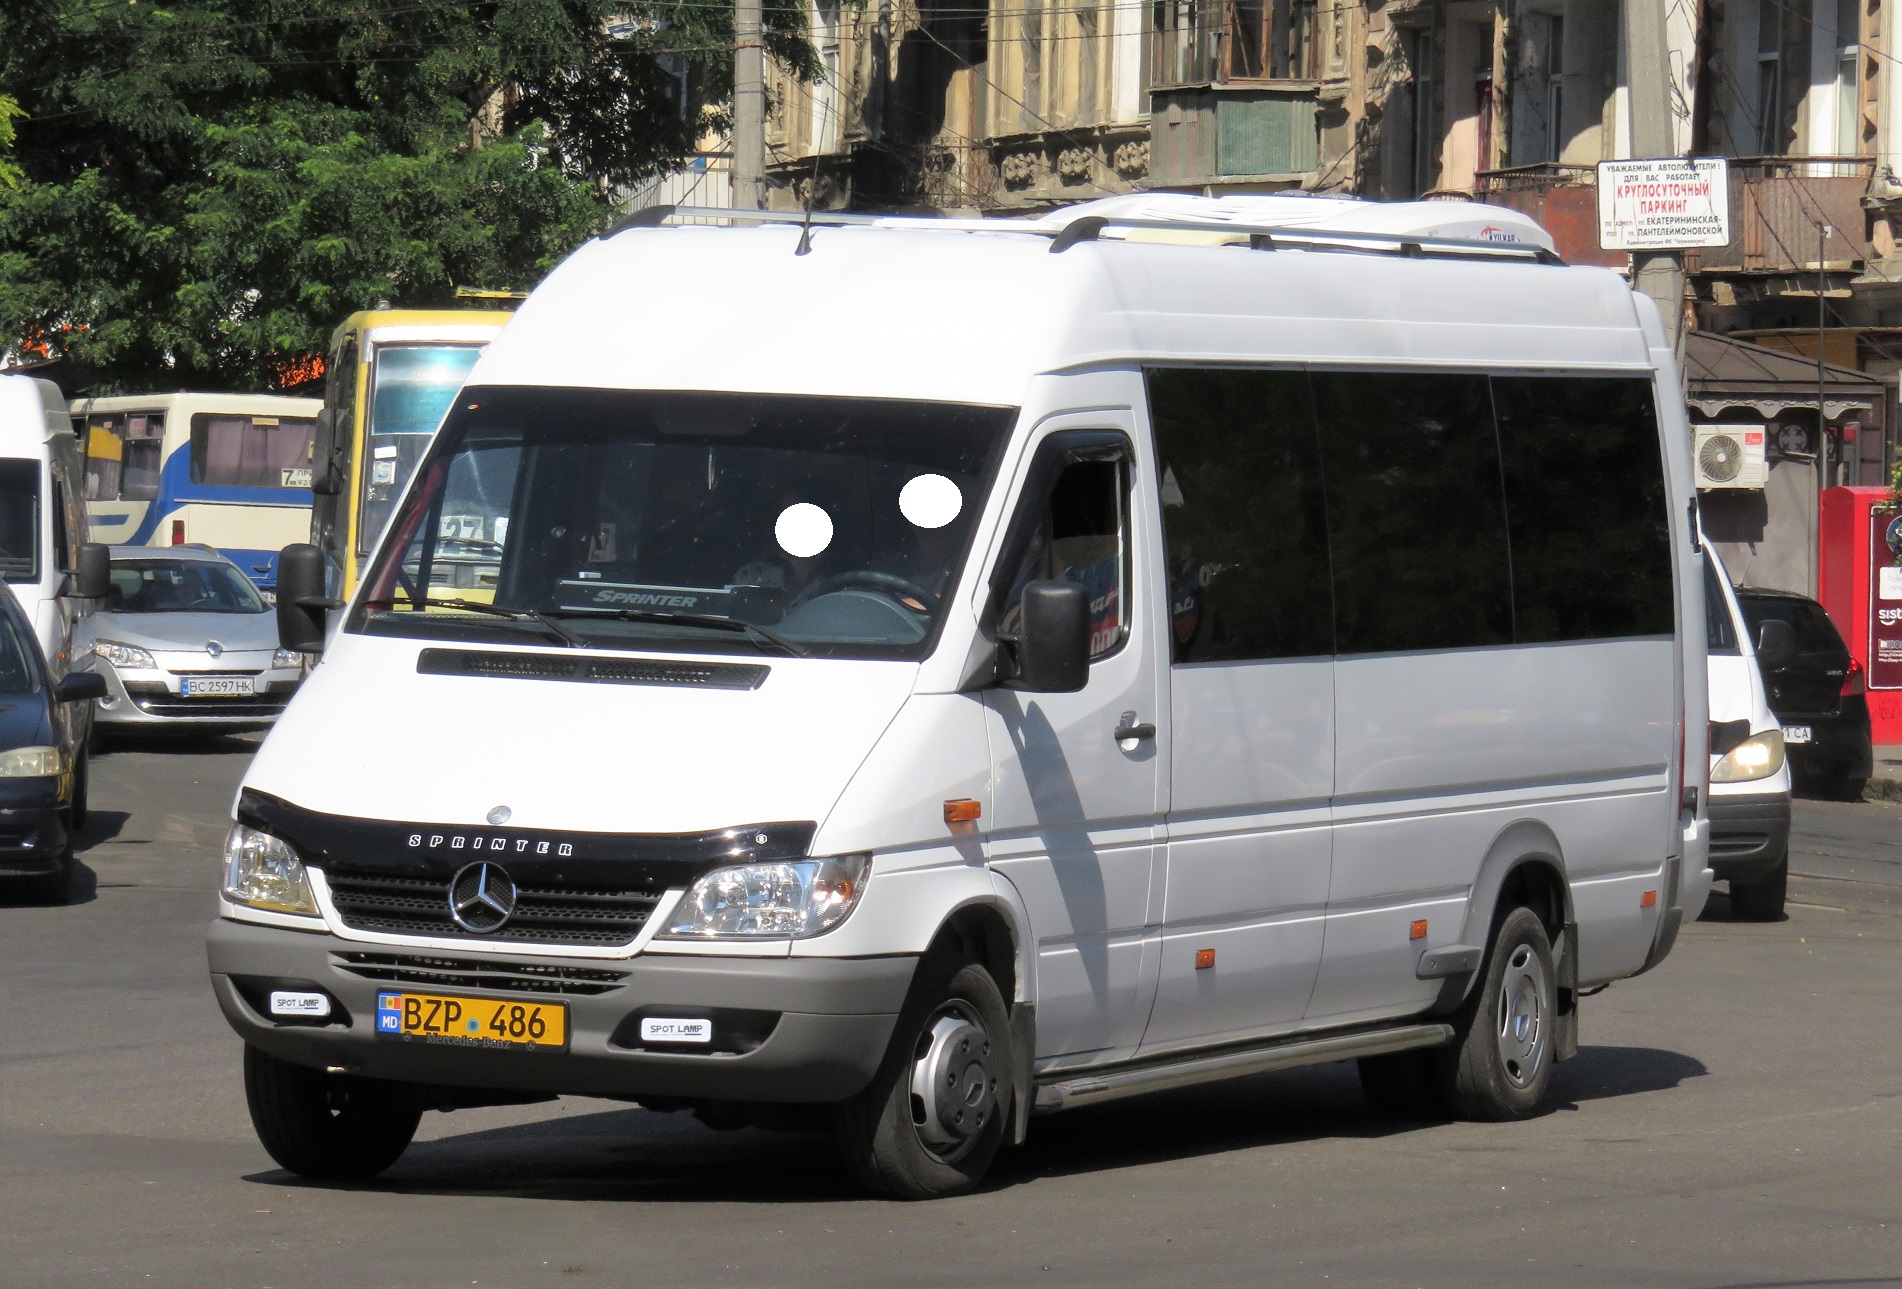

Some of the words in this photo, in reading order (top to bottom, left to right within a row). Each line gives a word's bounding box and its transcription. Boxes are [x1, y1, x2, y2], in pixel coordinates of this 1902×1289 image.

[1624, 174, 1639, 183] ДЛЯ
[1646, 174, 1659, 182] ВАС
[1666, 173, 1700, 181] РАБОТАЕТ
[1617, 179, 1710, 198] КРУГЛОСУТОЧНЫЙ
[1640, 200, 1687, 214] ПАРКИНГ
[1646, 216, 1722, 225] ЕКАТЕРИНИНСКАЯ-
[1637, 225, 1723, 237] ПАНТЕЛЕЙМОНОВСКОЙ
[282, 469, 295, 486] 7
[592, 590, 698, 608] SPRINTER
[189, 681, 207, 693] BC
[208, 681, 234, 693] 2597
[236, 680, 252, 693] HK
[408, 834, 573, 857] SPRINTER
[277, 998, 297, 1007] SPOT
[298, 999, 320, 1007] LAMP
[382, 1016, 398, 1029] MD
[404, 997, 462, 1033] BZP
[489, 1004, 546, 1039] 486
[650, 1025, 675, 1033] SPOT
[677, 1025, 703, 1033] LAMP
[425, 1032, 512, 1050] Mercedes-Benz
